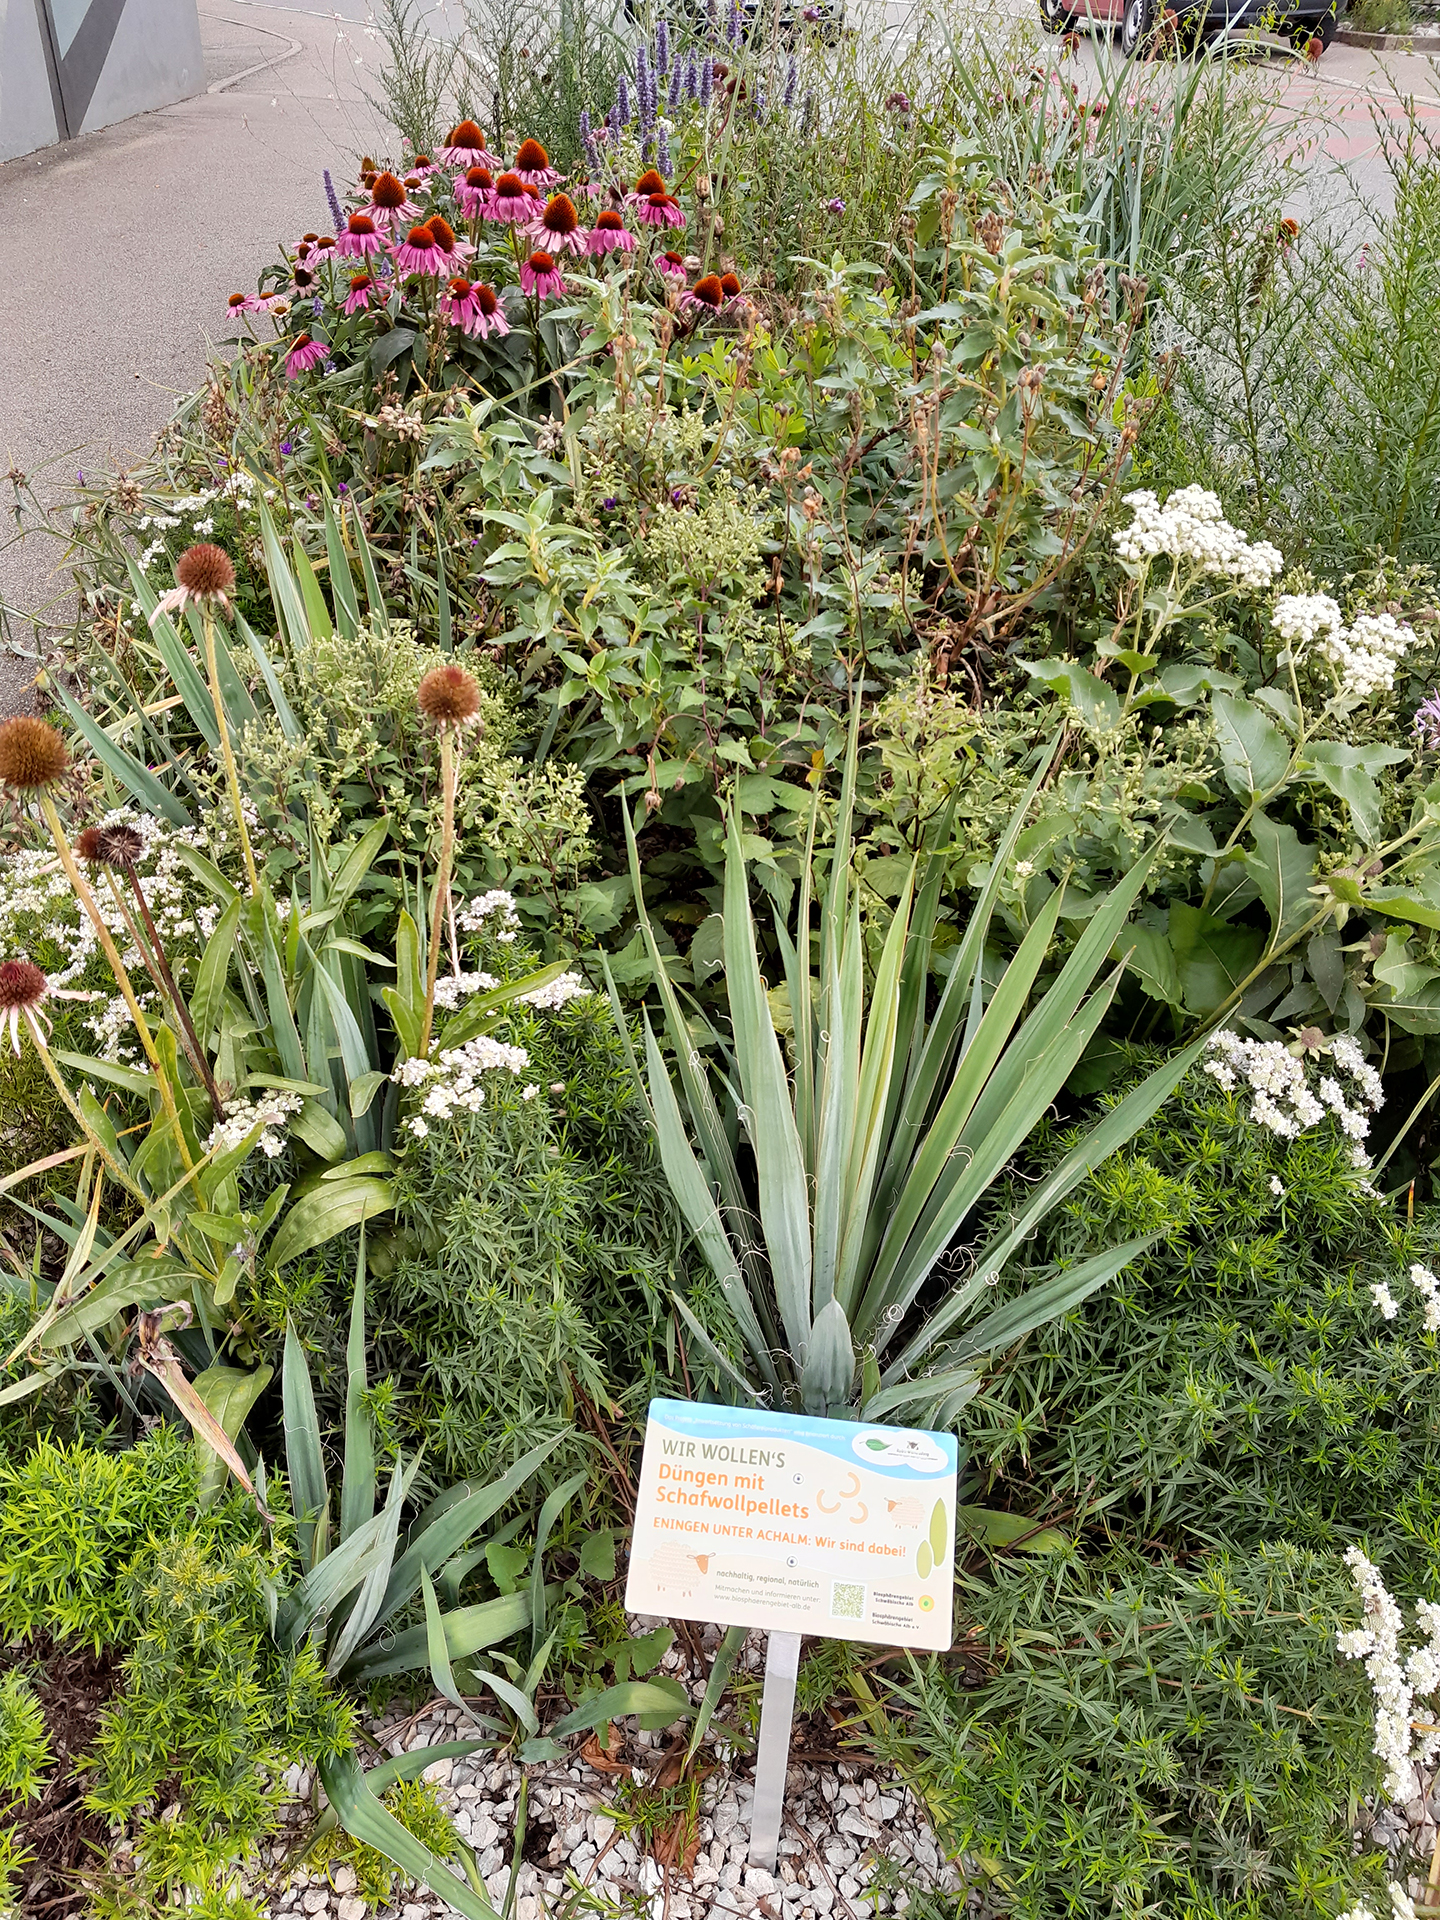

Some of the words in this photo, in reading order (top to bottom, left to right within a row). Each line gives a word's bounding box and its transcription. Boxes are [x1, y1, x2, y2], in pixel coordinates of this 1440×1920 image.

[662, 1439, 696, 1458] WIR
[658, 1463, 728, 1488] Düngen
[734, 1473, 765, 1491] mit
[656, 1485, 809, 1519] Schafwollpellets
[653, 1516, 709, 1533] ENINGEN
[713, 1523, 753, 1539] UNTER
[756, 1529, 812, 1546] ACHALM:
[815, 1536, 836, 1548] Wir
[839, 1539, 865, 1552] sind
[868, 1542, 906, 1557] dabei!
[716, 1570, 755, 1583] nachhaltig,
[756, 1575, 787, 1586] regional,
[788, 1578, 820, 1588] natürlich
[713, 1593, 811, 1611] www.biosphaerengebiet-alb.de
[714, 1584, 750, 1594] Mitmachen
[751, 1588, 764, 1596] und
[764, 1590, 801, 1601] informieren
